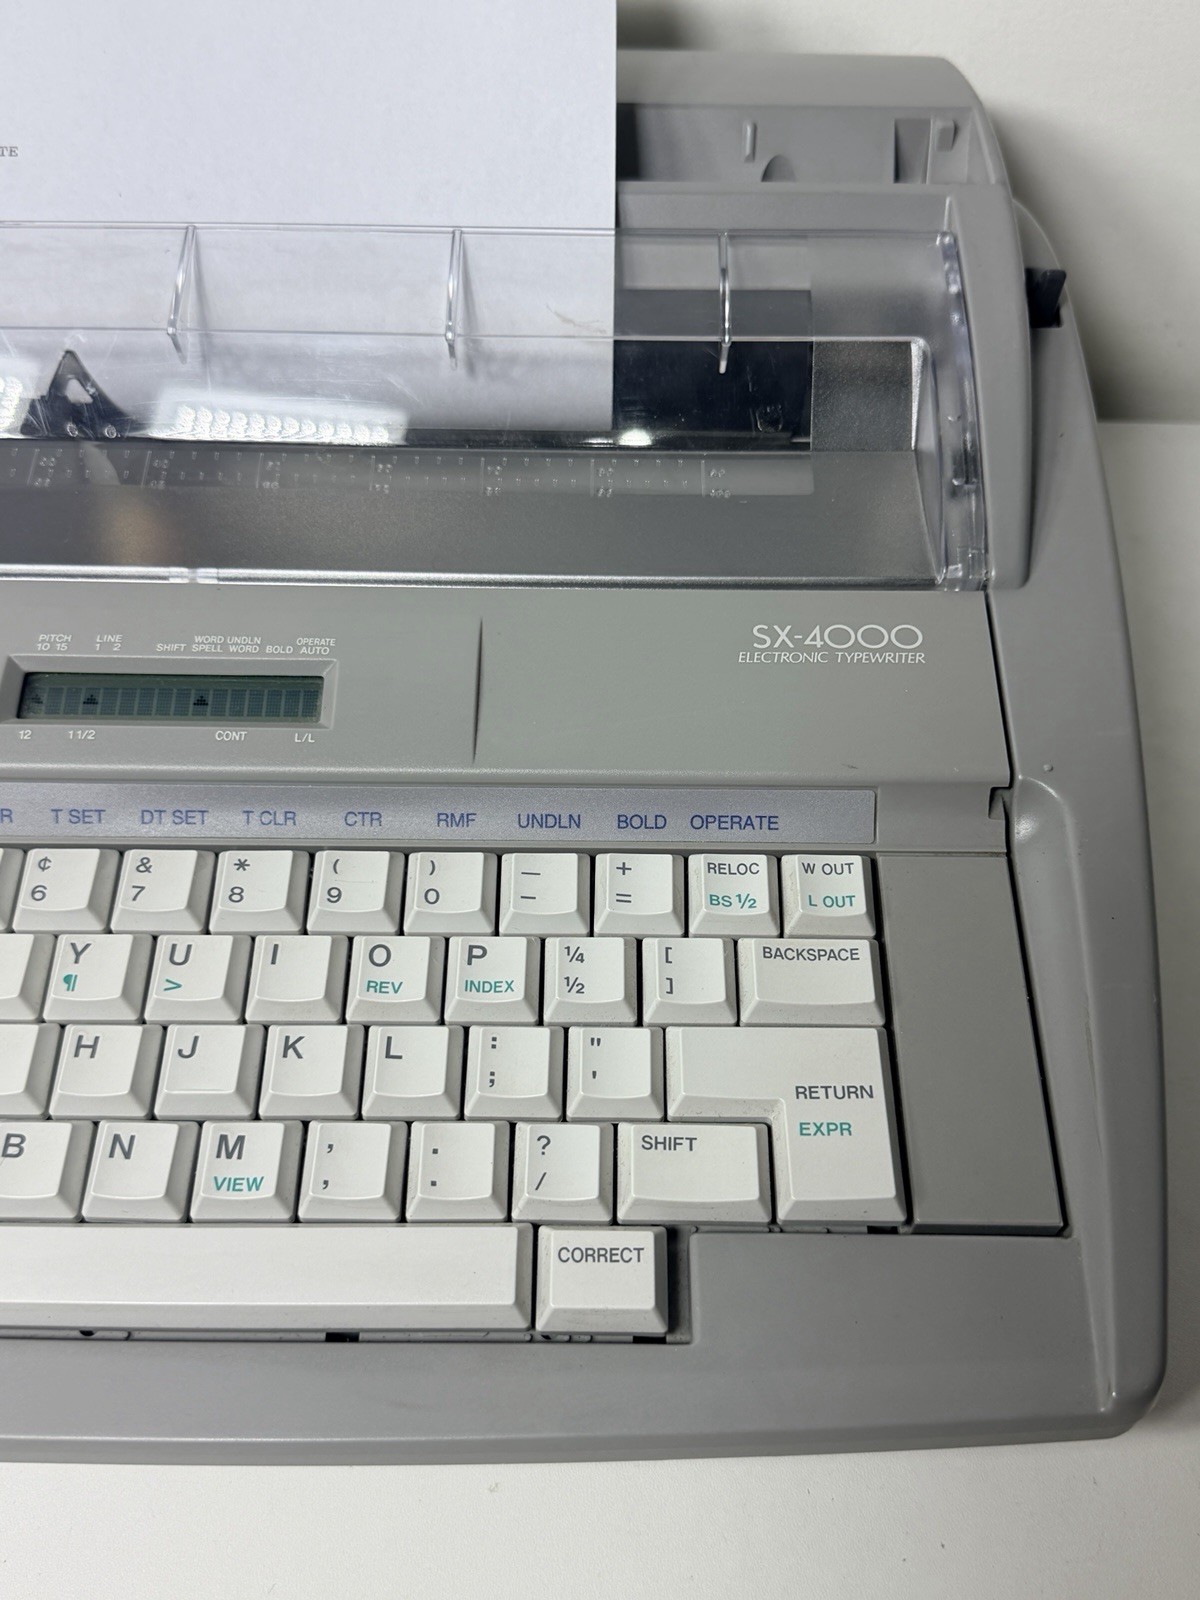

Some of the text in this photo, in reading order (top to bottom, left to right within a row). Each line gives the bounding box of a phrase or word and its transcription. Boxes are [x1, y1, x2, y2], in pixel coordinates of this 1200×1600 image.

[38, 633, 72, 645] PITCH
[96, 634, 123, 643] LINE
[193, 635, 262, 646] WORD UNDLN
[296, 637, 336, 649] OPERATE
[753, 625, 922, 649] SX-4000
[36, 642, 68, 651] 10 15
[95, 642, 122, 651] 1 2
[155, 642, 330, 655] SHIFT SPELL WORD BOLD AUTO
[738, 651, 926, 664] ELECTRONIC TYPEWRITER
[18, 729, 32, 740] 12
[214, 730, 248, 742] CONT
[294, 732, 315, 743] L/L
[50, 808, 106, 824] T SET
[141, 809, 209, 825] DT SET
[241, 809, 296, 826] T CLR
[345, 811, 382, 826] CTR
[437, 813, 476, 827] RMF
[518, 814, 580, 828] UNDLN
[618, 814, 667, 829] BOLD
[690, 815, 778, 830] OPERATE
[136, 857, 152, 873] &
[332, 858, 340, 875] (
[428, 859, 436, 876] )
[615, 861, 632, 876] +
[706, 861, 760, 876] RELOC
[801, 862, 855, 876] W OUT
[31, 885, 47, 901] 6
[131, 884, 146, 902] 7
[229, 887, 244, 903] 8
[327, 887, 342, 903] 9
[709, 893, 733, 908] BS
[808, 894, 856, 909] L OUT
[70, 943, 91, 964] Y
[169, 944, 192, 965] U
[270, 943, 279, 965] I
[369, 944, 391, 967] O
[467, 945, 487, 965] P
[664, 946, 673, 964] [
[763, 946, 859, 961] BACKSPACE
[366, 979, 404, 994] REV
[464, 979, 515, 994] INDEX
[665, 977, 674, 995] ]
[74, 1035, 99, 1058] H
[178, 1036, 199, 1058] J
[283, 1036, 304, 1059] K
[385, 1036, 402, 1059] L
[796, 1085, 873, 1099] RETURN
[800, 1122, 851, 1136] EXPR
[1, 1133, 26, 1158] B
[109, 1134, 135, 1159] N
[216, 1134, 245, 1160] M
[536, 1134, 551, 1156] ?
[642, 1135, 697, 1151] SHIFT
[214, 1176, 264, 1191] VIEW
[534, 1171, 547, 1191] /
[558, 1247, 644, 1263] CORRECT
